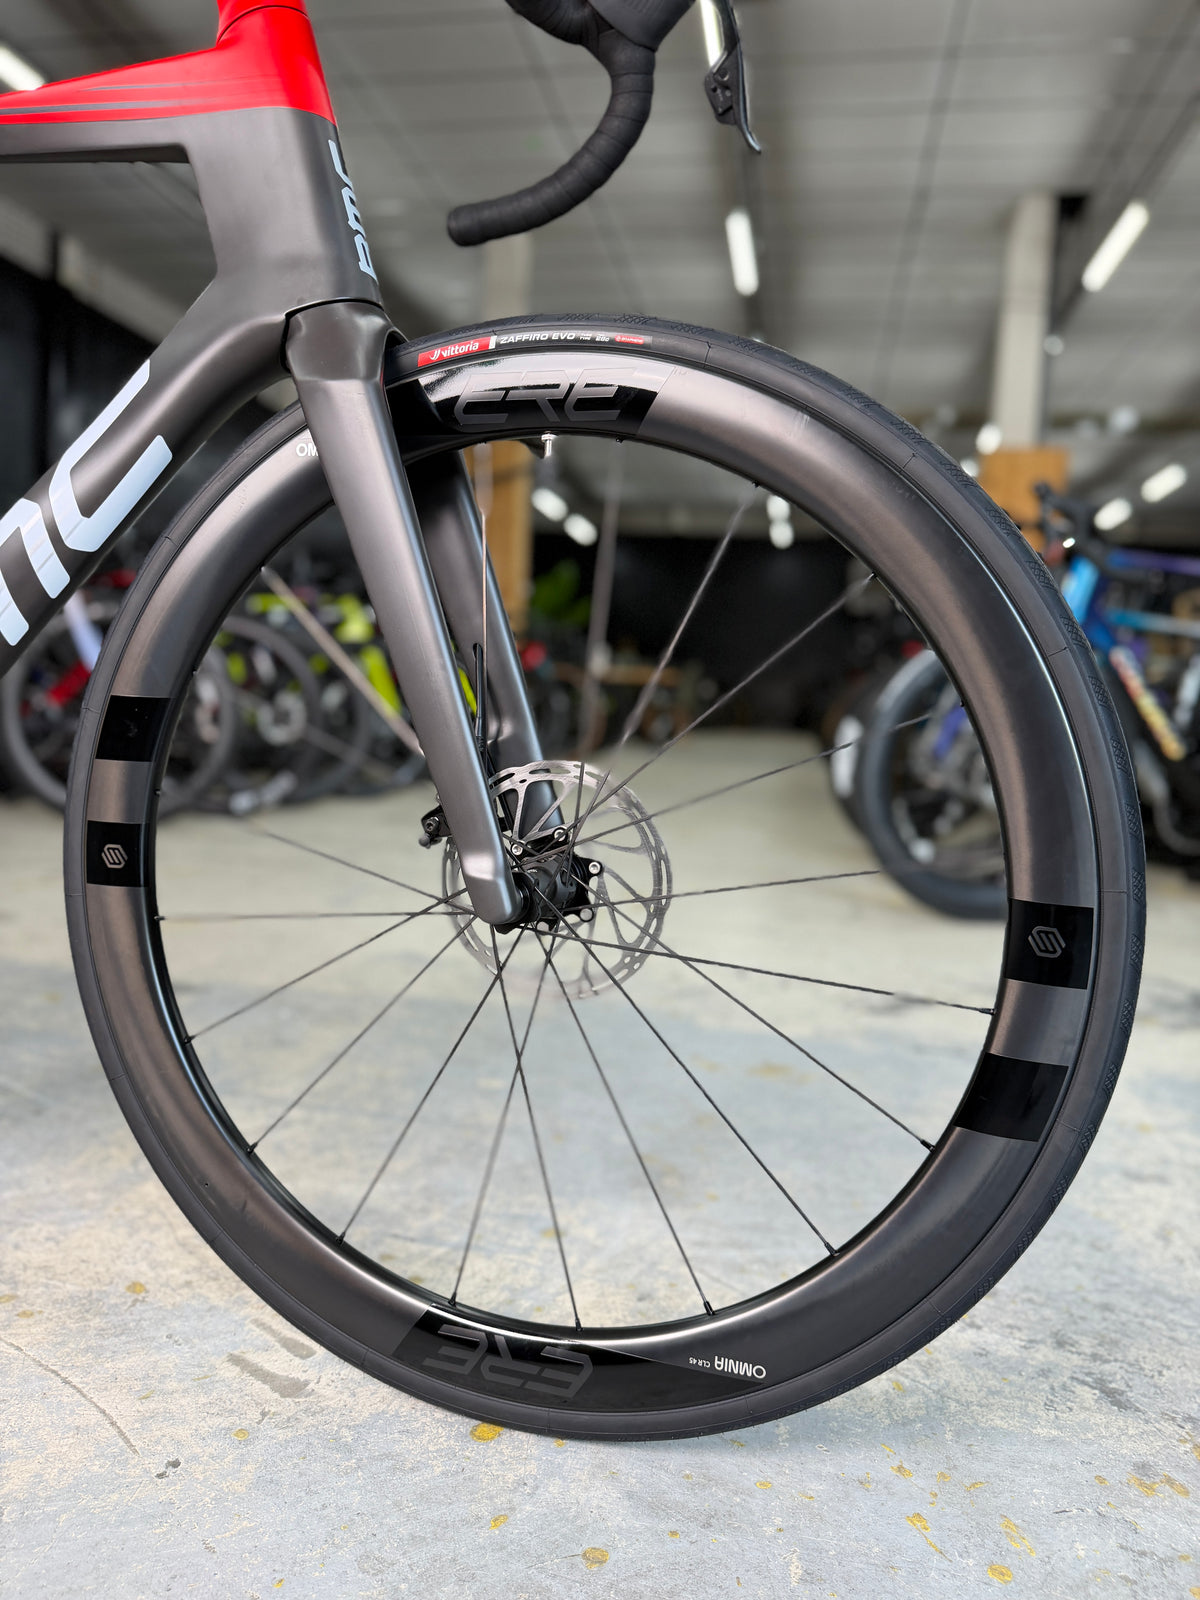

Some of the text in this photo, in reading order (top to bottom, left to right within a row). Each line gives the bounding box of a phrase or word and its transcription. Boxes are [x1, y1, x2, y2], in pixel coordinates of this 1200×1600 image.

[441, 341, 479, 357] vittoria
[500, 333, 549, 344] ZAFFIRO
[551, 332, 576, 340] EVO
[454, 367, 637, 425] ERE
[422, 1323, 593, 1398] ERE
[688, 1355, 767, 1379] OMNIA CLR 45
